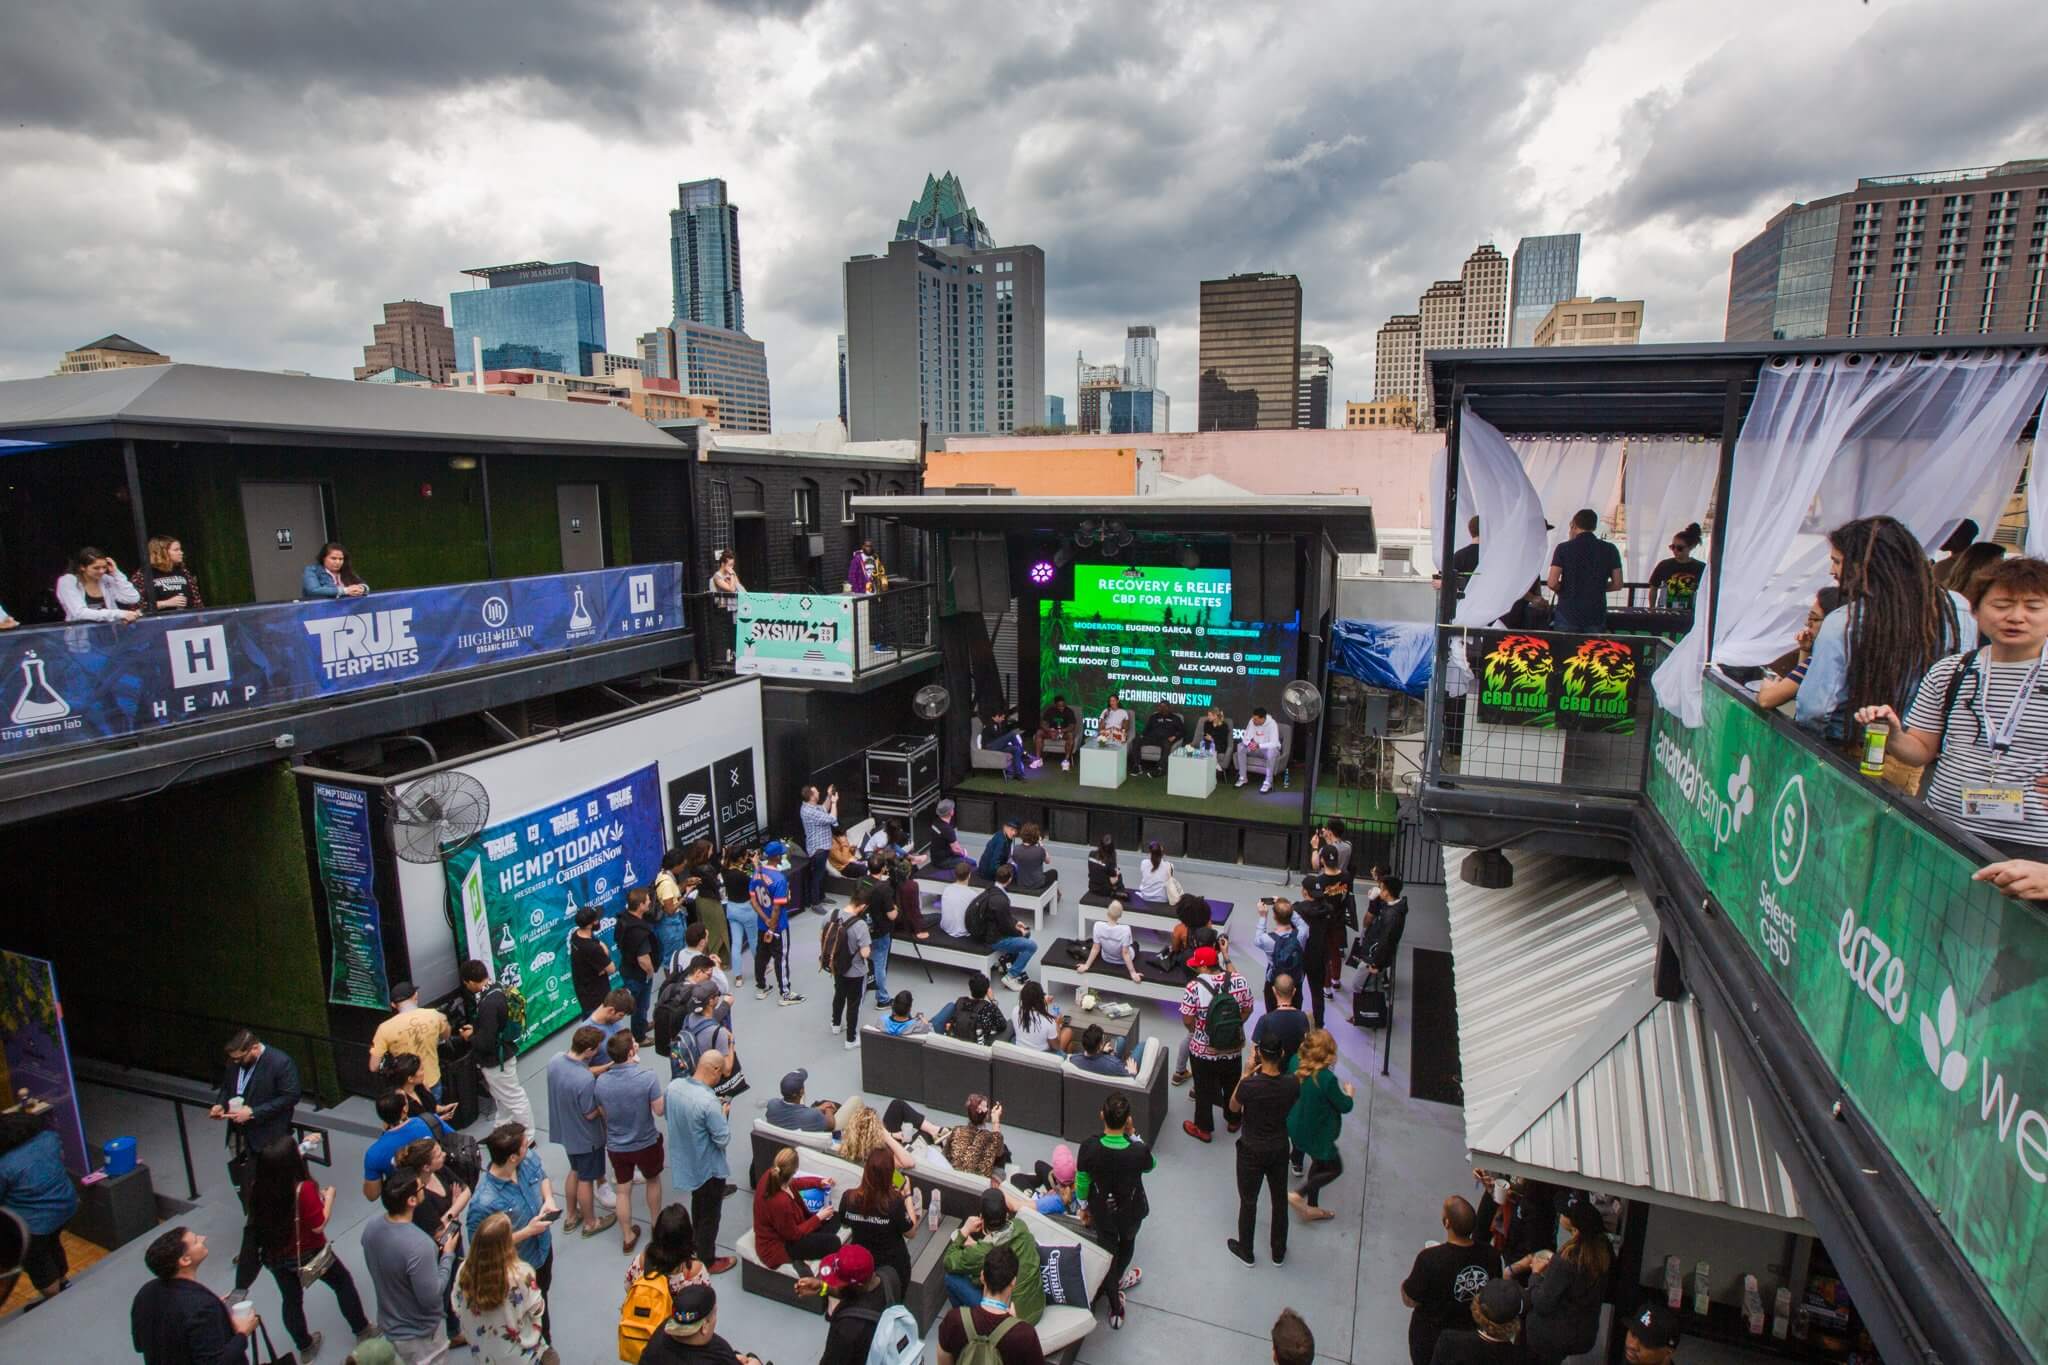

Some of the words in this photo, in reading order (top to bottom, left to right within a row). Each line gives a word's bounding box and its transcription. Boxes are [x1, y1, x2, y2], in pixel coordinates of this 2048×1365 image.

[532, 266, 569, 278] MARRIOTT
[1098, 579, 1169, 592] RECOVERY
[1174, 583, 1183, 593] &
[1112, 594, 1136, 604] CBD
[1139, 595, 1162, 605] FOR
[1164, 596, 1222, 607] ATHLETES
[622, 615, 664, 632] HEMP
[1125, 624, 1160, 633] EUGENIO
[1162, 625, 1192, 635] GARCIA
[304, 607, 419, 663] TRUE
[458, 632, 494, 649] HIGH
[501, 625, 534, 639] HEMP
[184, 636, 215, 674] H
[1059, 644, 1079, 652] MATT
[1080, 645, 1110, 653] BARNES
[1204, 652, 1230, 660] JONES
[322, 649, 420, 679] TERPENES
[1078, 657, 1108, 666] MOODY
[1178, 663, 1198, 672] ALEX
[1199, 665, 1234, 673] CAPANO
[1107, 673, 1130, 681] BETSY
[1131, 674, 1168, 683] HOLLAND
[153, 685, 257, 718] HEMP
[1482, 690, 1512, 706] CBD
[1516, 692, 1548, 708] LION
[1559, 695, 1591, 712] CBD
[1594, 698, 1629, 714] LION
[1, 729, 23, 740] the
[25, 724, 61, 738] green
[64, 718, 82, 730] lab
[317, 786, 358, 802] HEMPTODAY
[1655, 729, 1733, 852] anandahemp
[721, 794, 754, 823] BLISS
[677, 820, 693, 832] HEMP
[694, 811, 711, 824] BLACK
[500, 824, 610, 893] HEMPTODAY
[514, 880, 546, 901] PRESENTED
[1758, 879, 1797, 942] Select
[1760, 922, 1790, 967] CBD
[1040, 1265, 1051, 1295] Now
[1049, 1249, 1067, 1304] Cannabis
